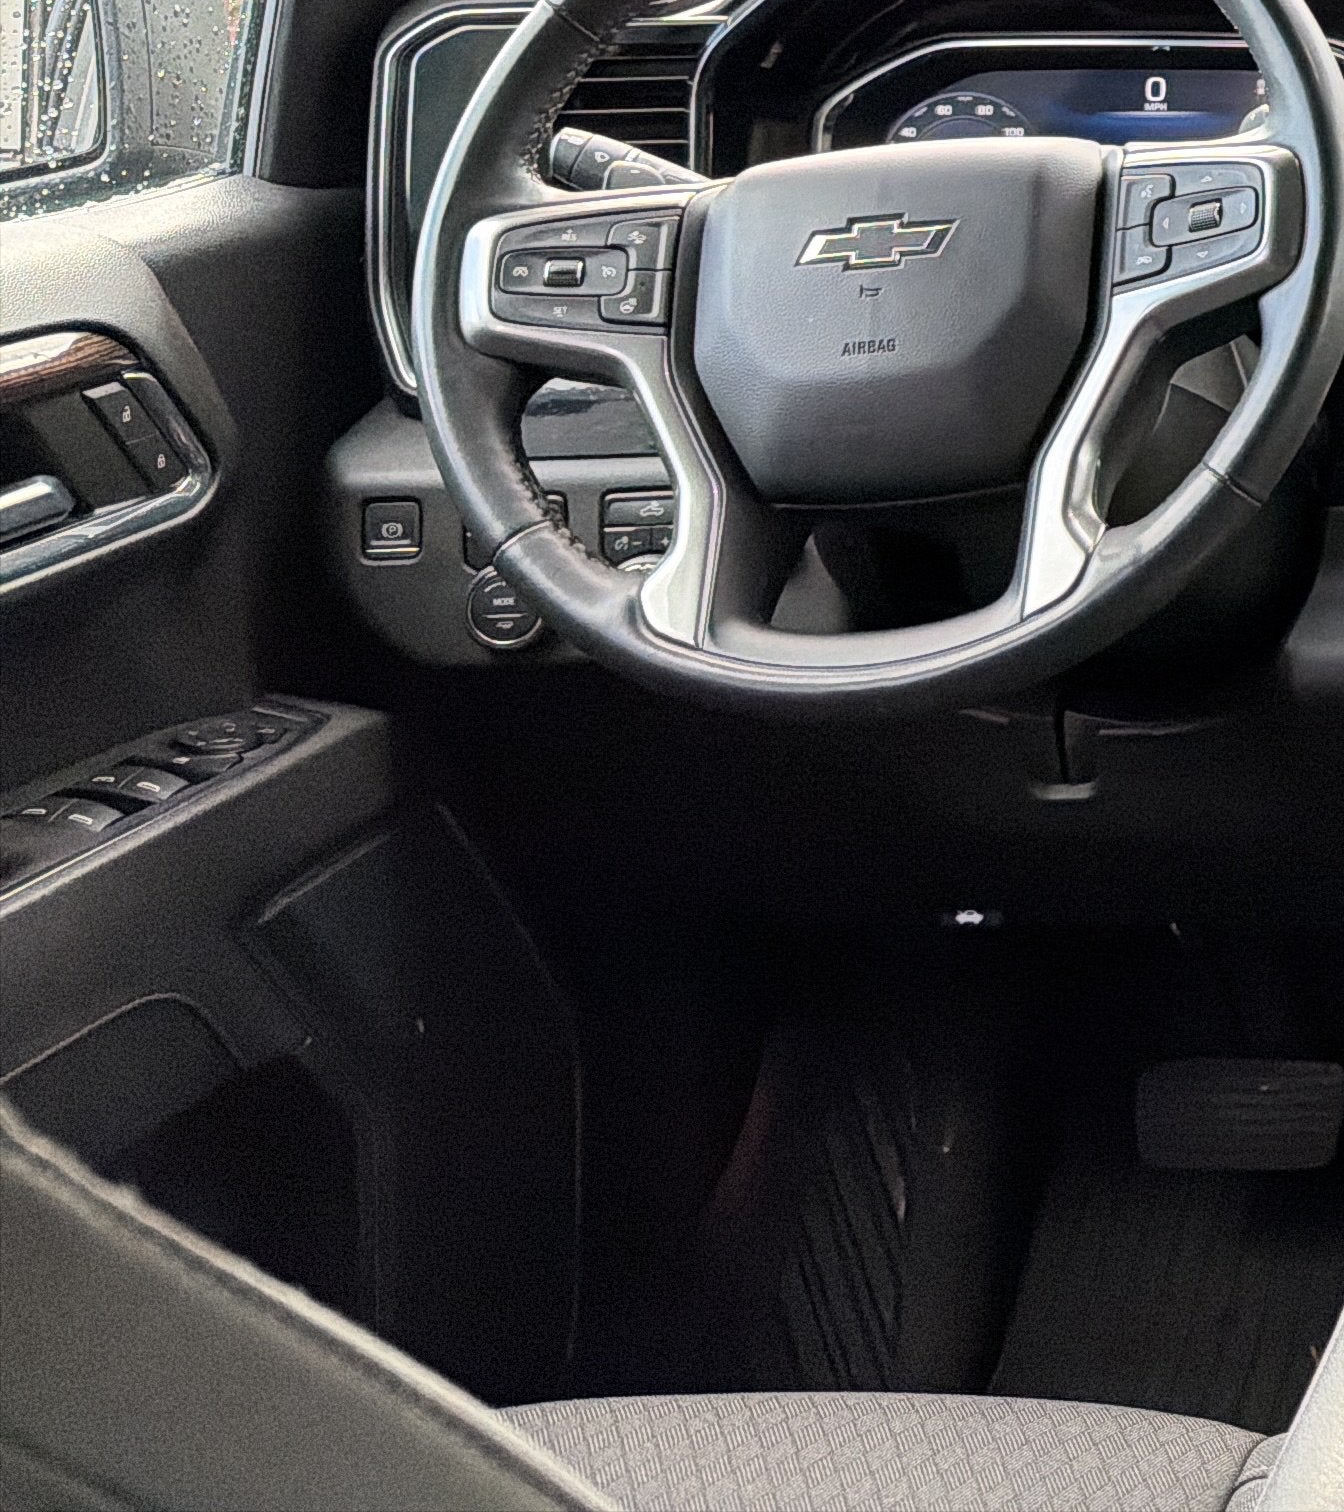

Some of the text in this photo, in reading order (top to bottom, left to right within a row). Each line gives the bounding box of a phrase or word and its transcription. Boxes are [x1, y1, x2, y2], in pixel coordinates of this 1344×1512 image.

[1144, 76, 1167, 102] 0
[1144, 102, 1167, 111] MPH
[553, 306, 567, 314] SET
[841, 338, 896, 356] AIRBAG
[493, 596, 515, 606] MODE
